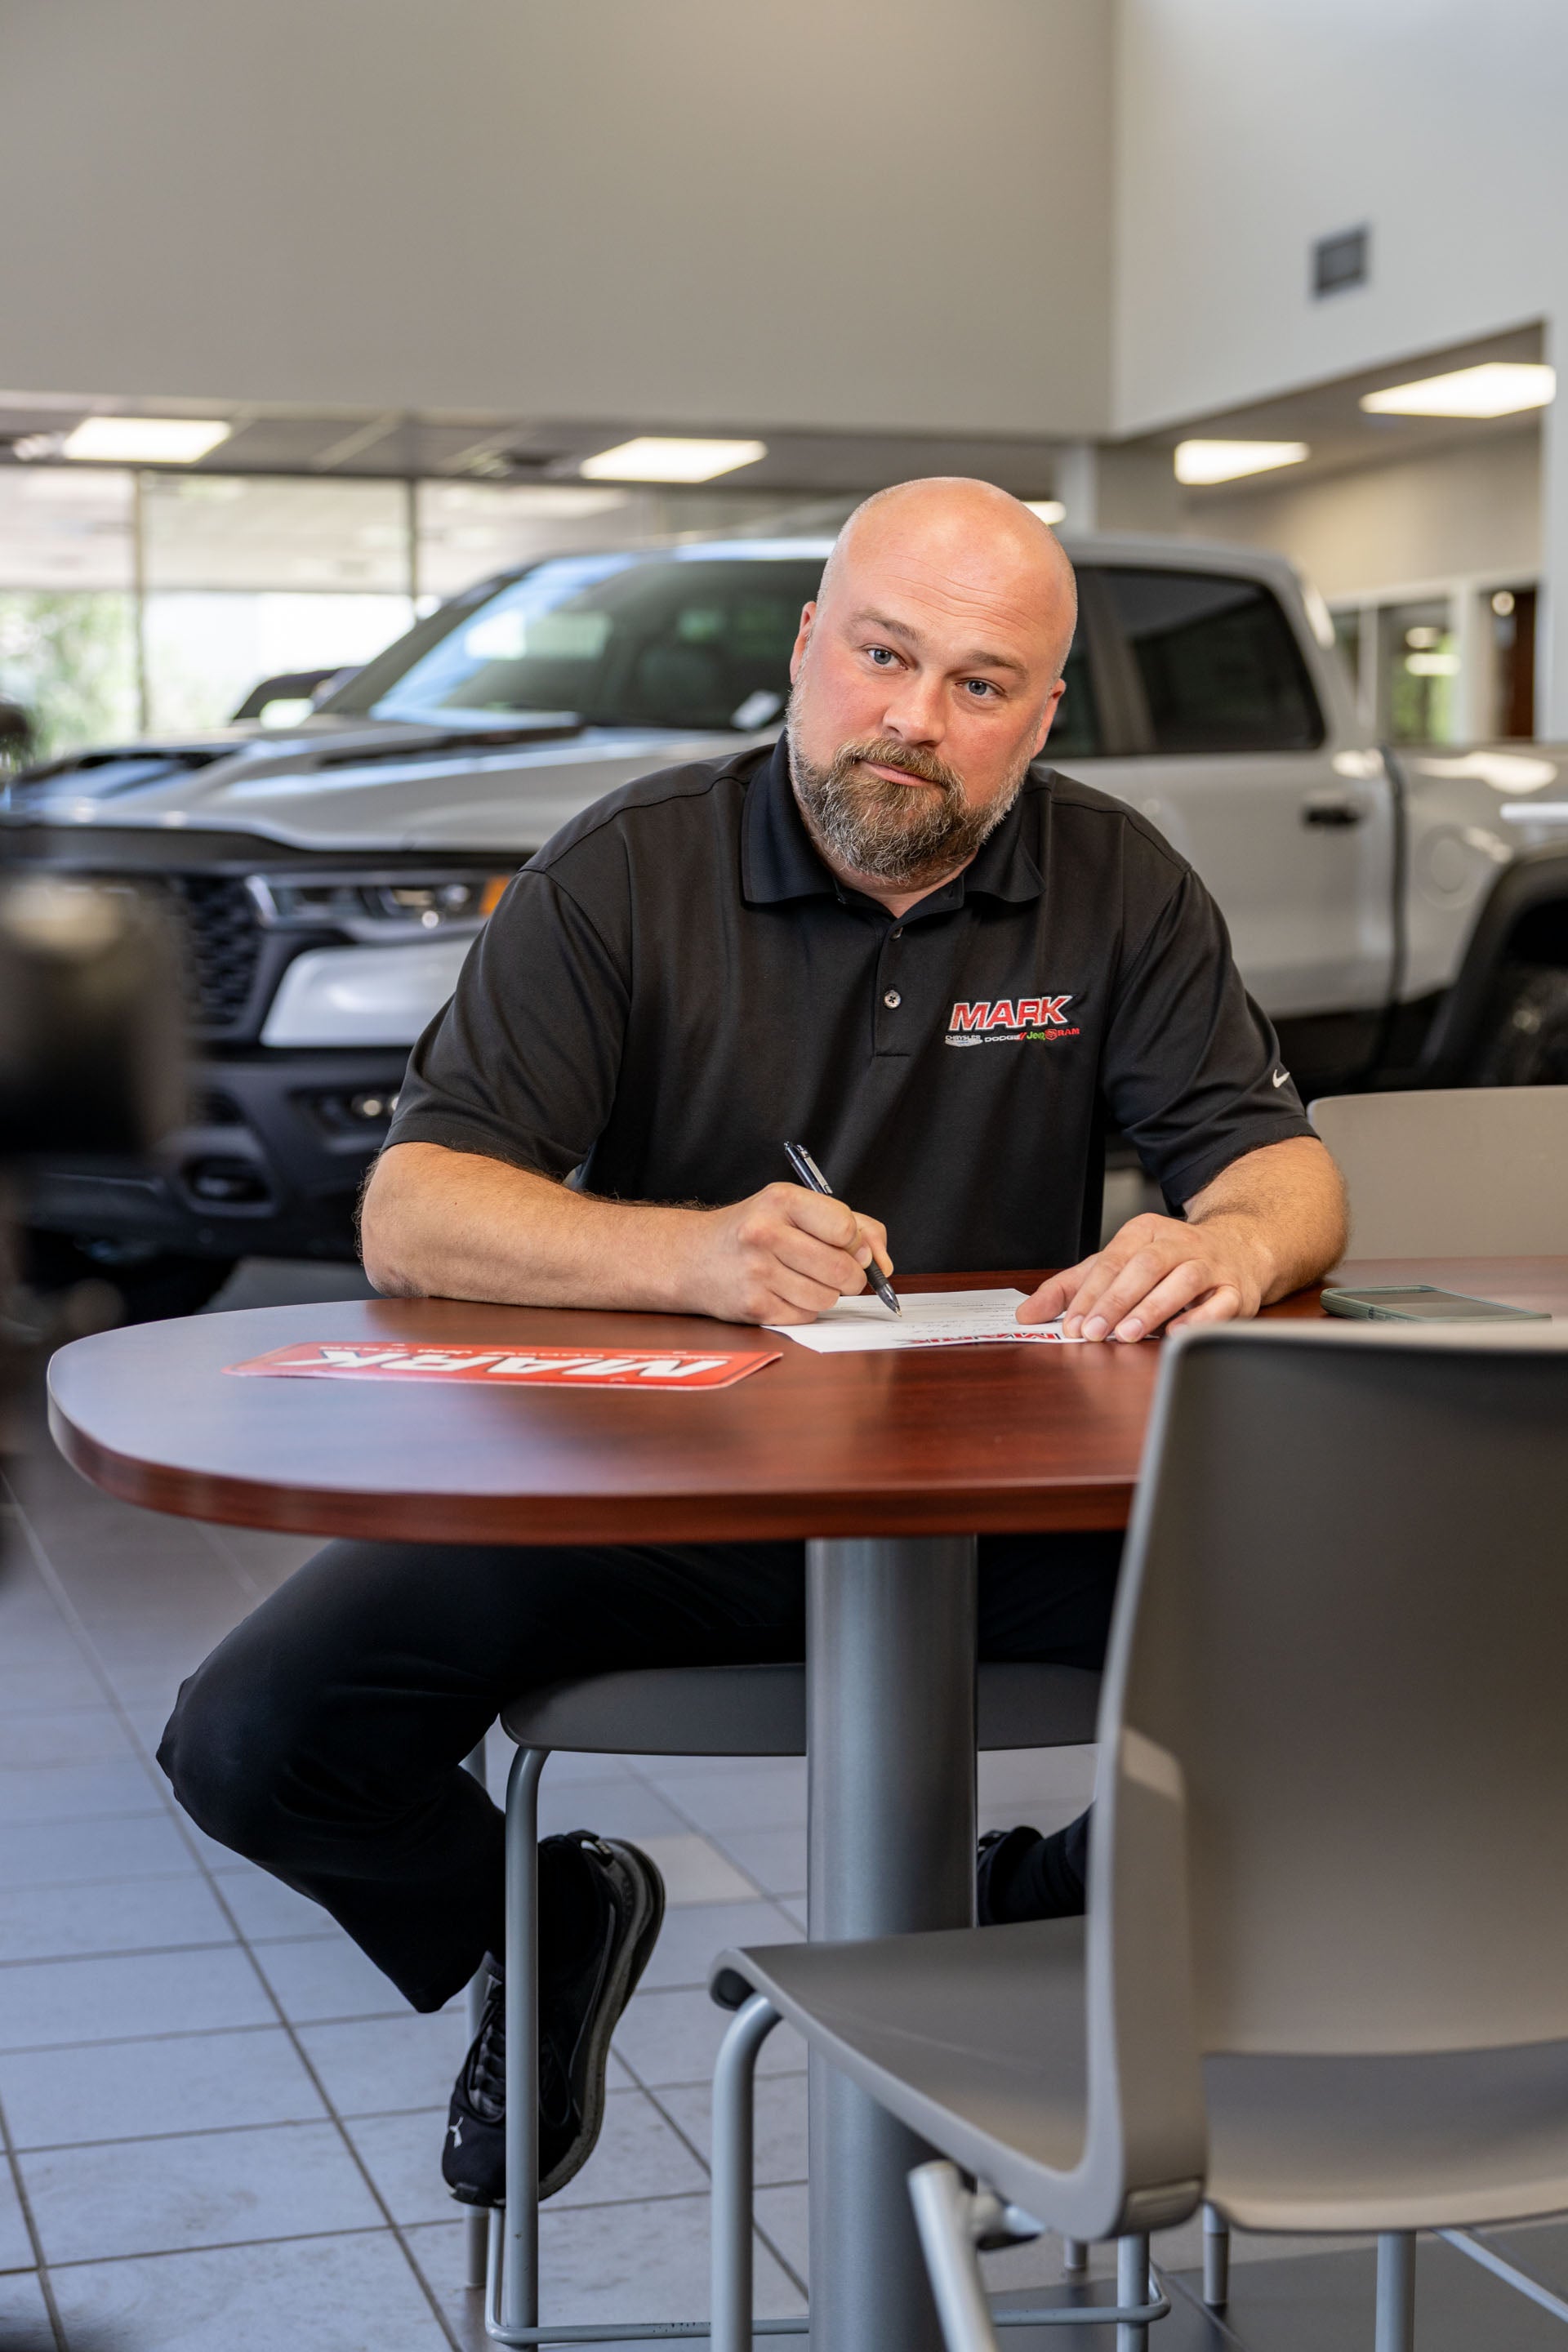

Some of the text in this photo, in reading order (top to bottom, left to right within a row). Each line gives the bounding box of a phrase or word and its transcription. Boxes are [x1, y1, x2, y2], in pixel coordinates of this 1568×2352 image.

[948, 995, 1073, 1031] MARK
[985, 1035, 1021, 1043] DODGE
[1057, 1027, 1080, 1037] RAM
[273, 1350, 728, 1378] MARK
